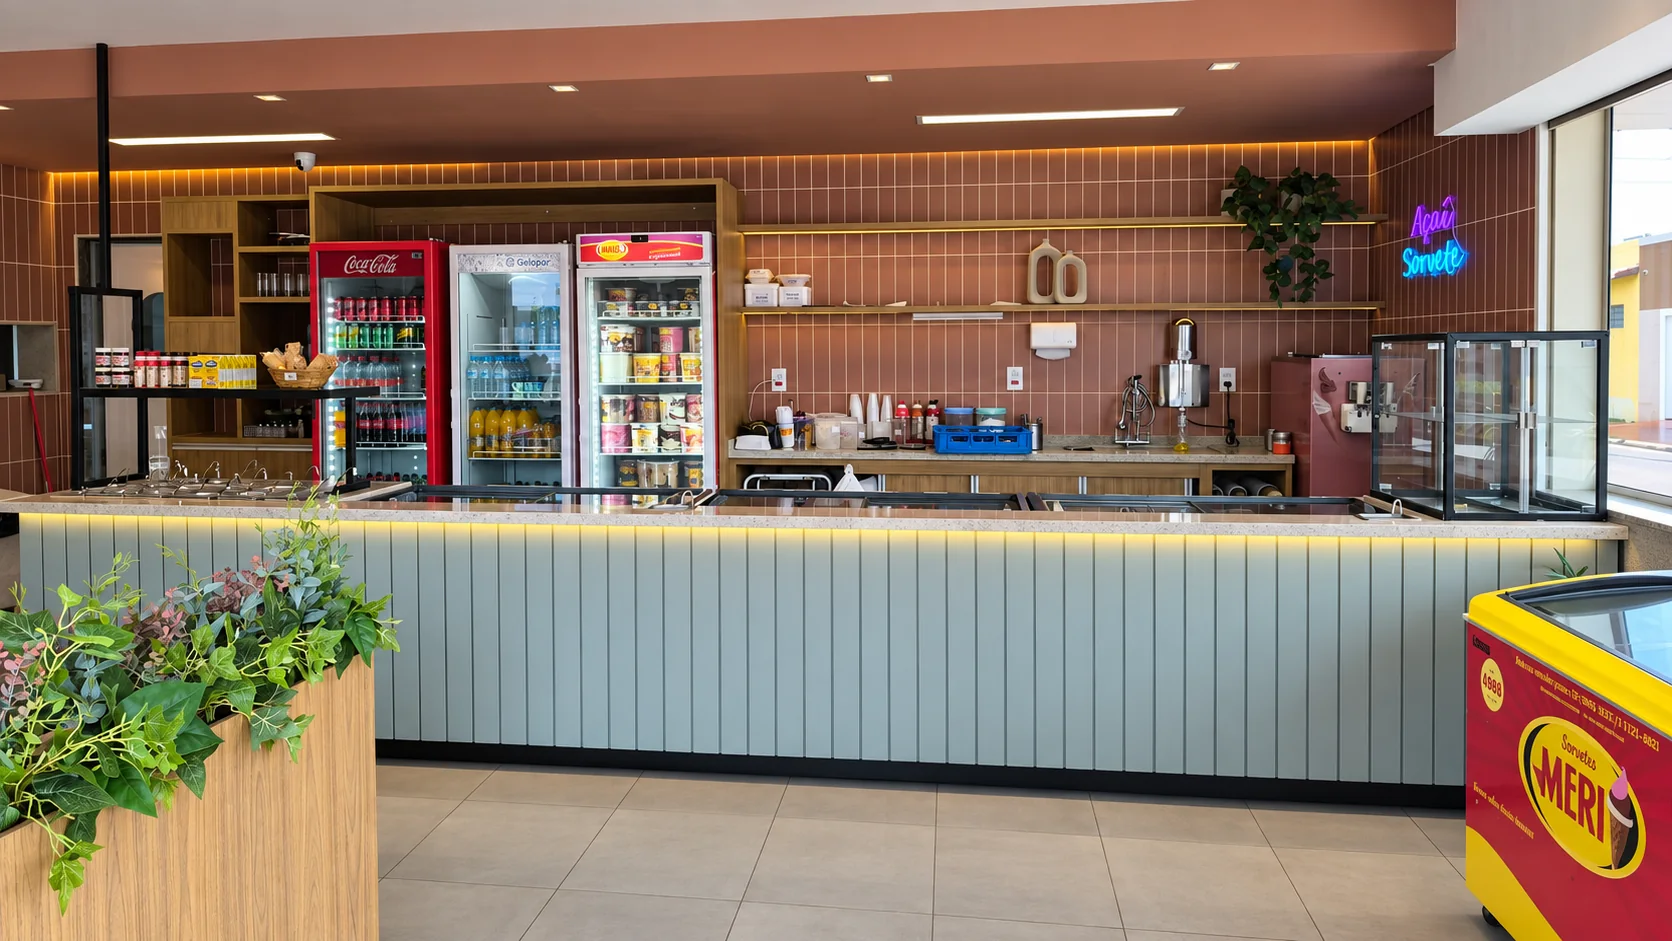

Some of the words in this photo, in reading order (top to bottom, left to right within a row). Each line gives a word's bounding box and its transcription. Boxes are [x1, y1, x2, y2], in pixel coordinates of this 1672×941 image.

[344, 253, 399, 274] Coca-Cola
[1402, 240, 1466, 278] Sorvete
[1561, 733, 1597, 771] Sorvetes
[1531, 745, 1605, 844] MERI
